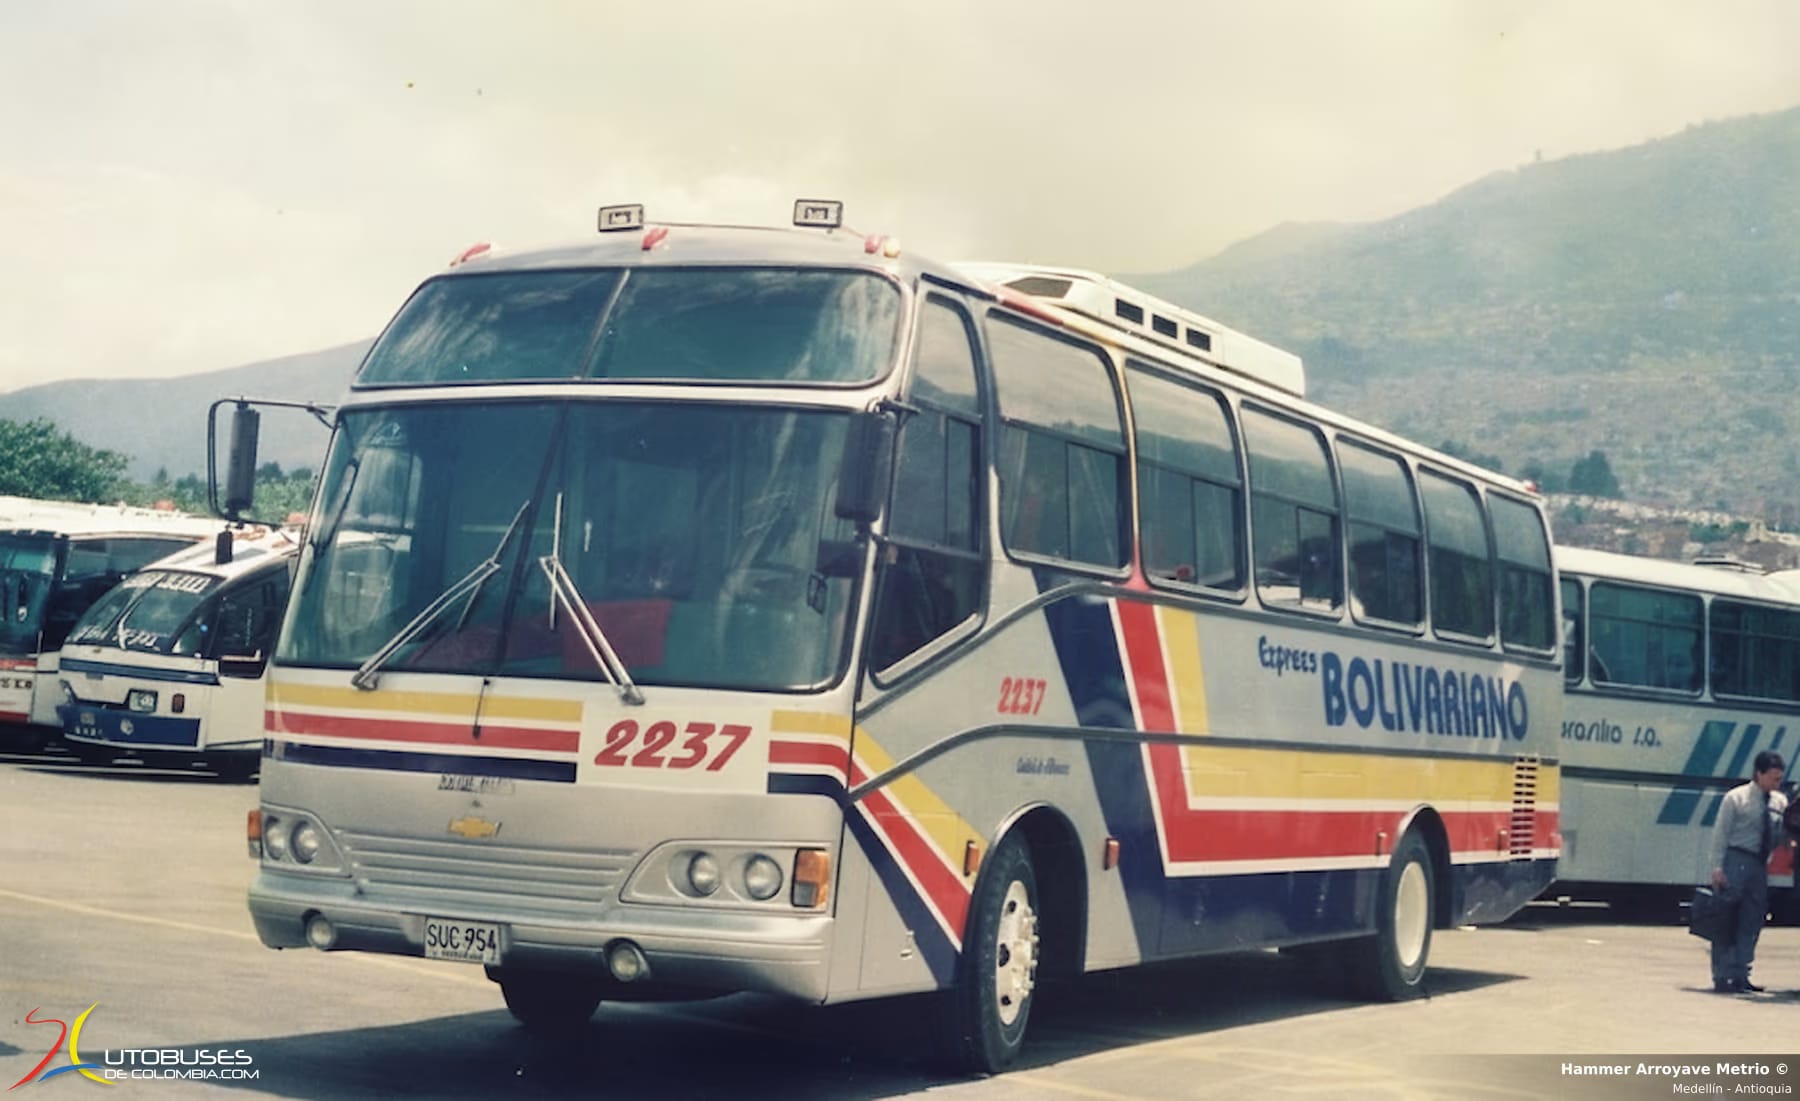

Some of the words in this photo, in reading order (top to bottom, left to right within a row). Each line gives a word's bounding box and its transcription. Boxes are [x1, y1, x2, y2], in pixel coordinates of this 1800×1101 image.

[997, 677, 1047, 715] 2237
[1321, 652, 1528, 741] BOLIVARIANO
[594, 719, 752, 771] 2237
[427, 924, 460, 949] SUC
